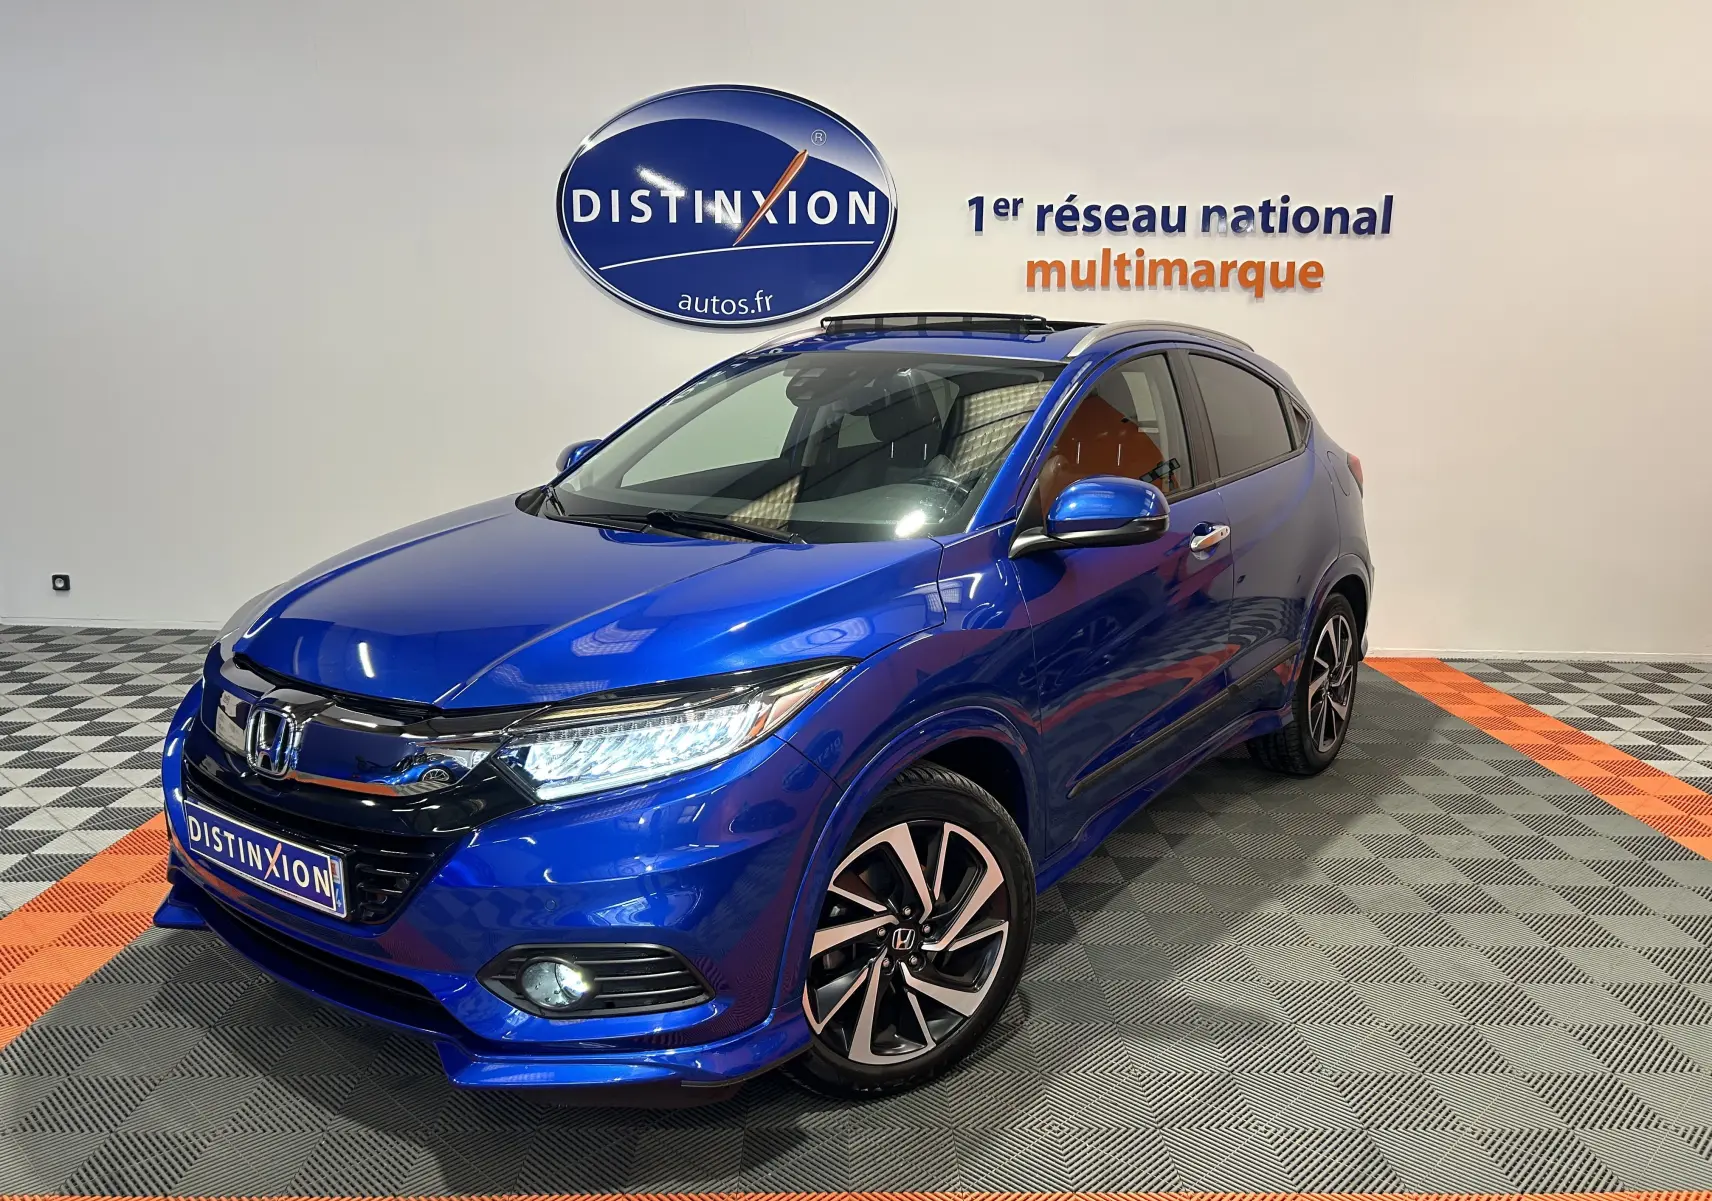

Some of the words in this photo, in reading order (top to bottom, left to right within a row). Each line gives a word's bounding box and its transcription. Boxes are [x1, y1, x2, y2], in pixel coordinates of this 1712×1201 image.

[967, 195, 1024, 232] 1er
[1036, 193, 1187, 233] réseau
[1201, 194, 1394, 235] national
[1026, 247, 1325, 298] multimarque
[678, 289, 773, 315] autos.fr
[187, 815, 331, 898] DISTINXION
